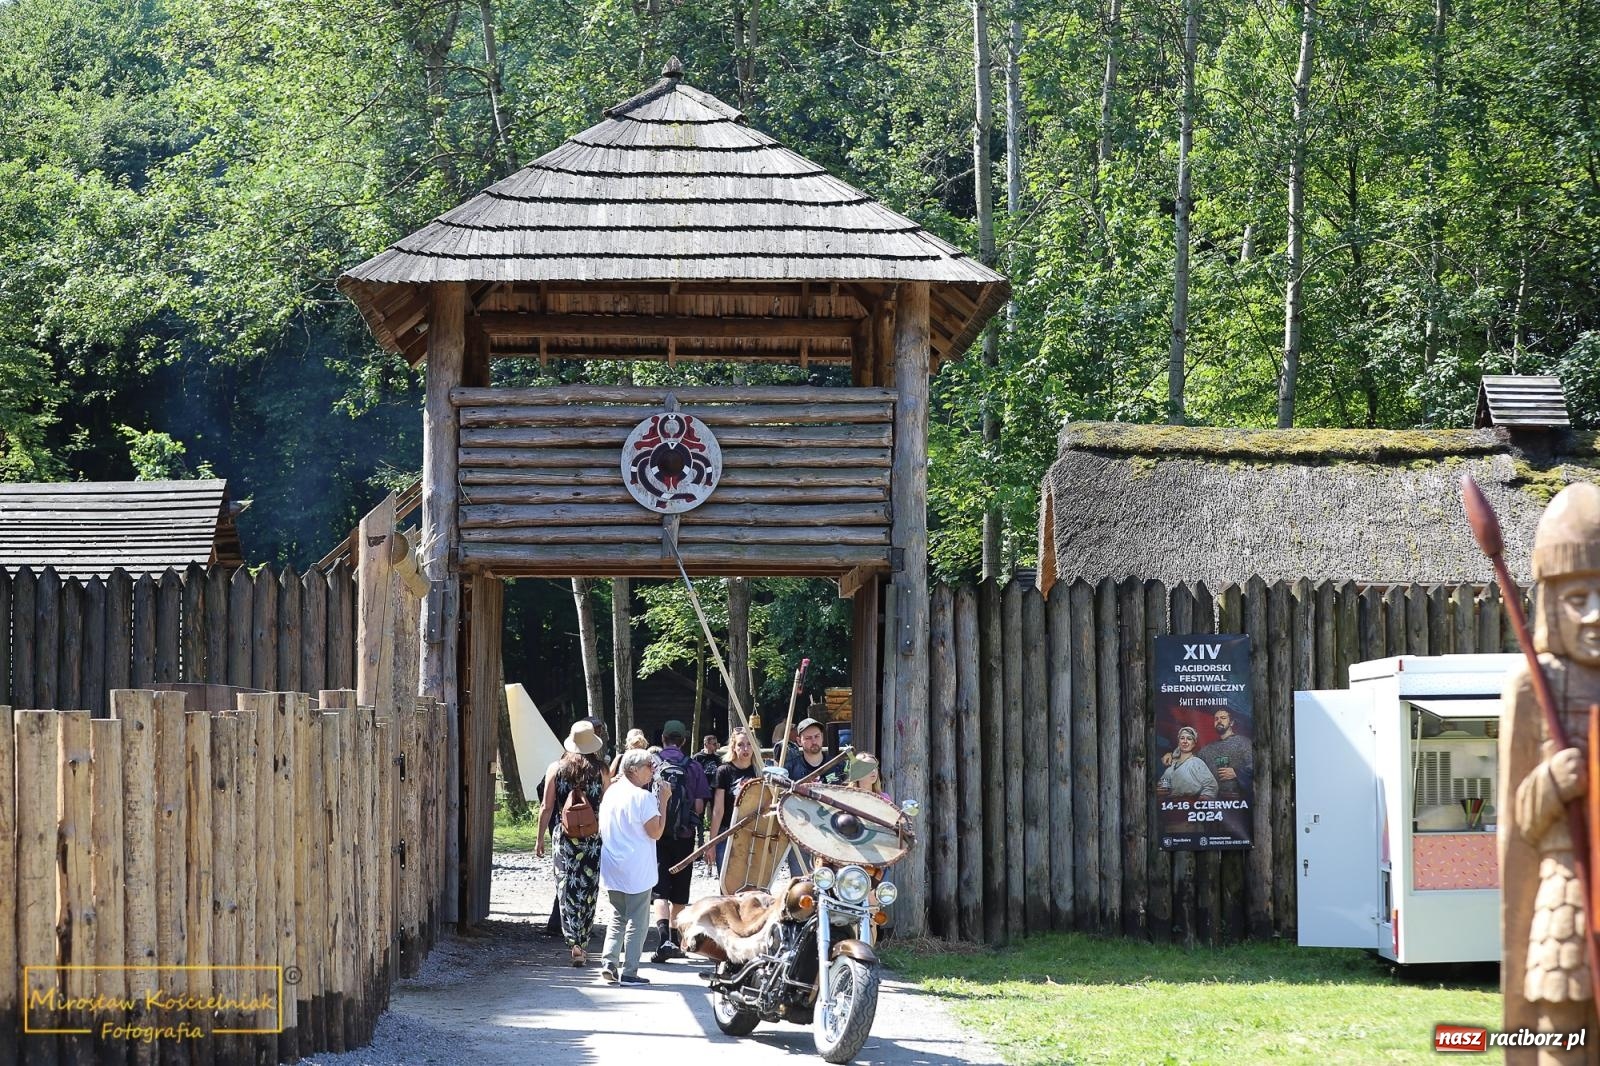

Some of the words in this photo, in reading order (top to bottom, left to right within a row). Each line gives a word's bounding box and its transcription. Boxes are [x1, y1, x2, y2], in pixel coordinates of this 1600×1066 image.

[1183, 644, 1221, 660] XIV
[1174, 664, 1231, 672] RACIBORSKI
[1179, 674, 1227, 682] FESTIWAL
[1161, 683, 1245, 692] ŚREDNIOWIECZNY
[1195, 697, 1228, 706] EMPORIUM
[1161, 801, 1190, 810] 14-16
[1193, 800, 1248, 809] CZERWCA
[1187, 811, 1223, 821] 2024
